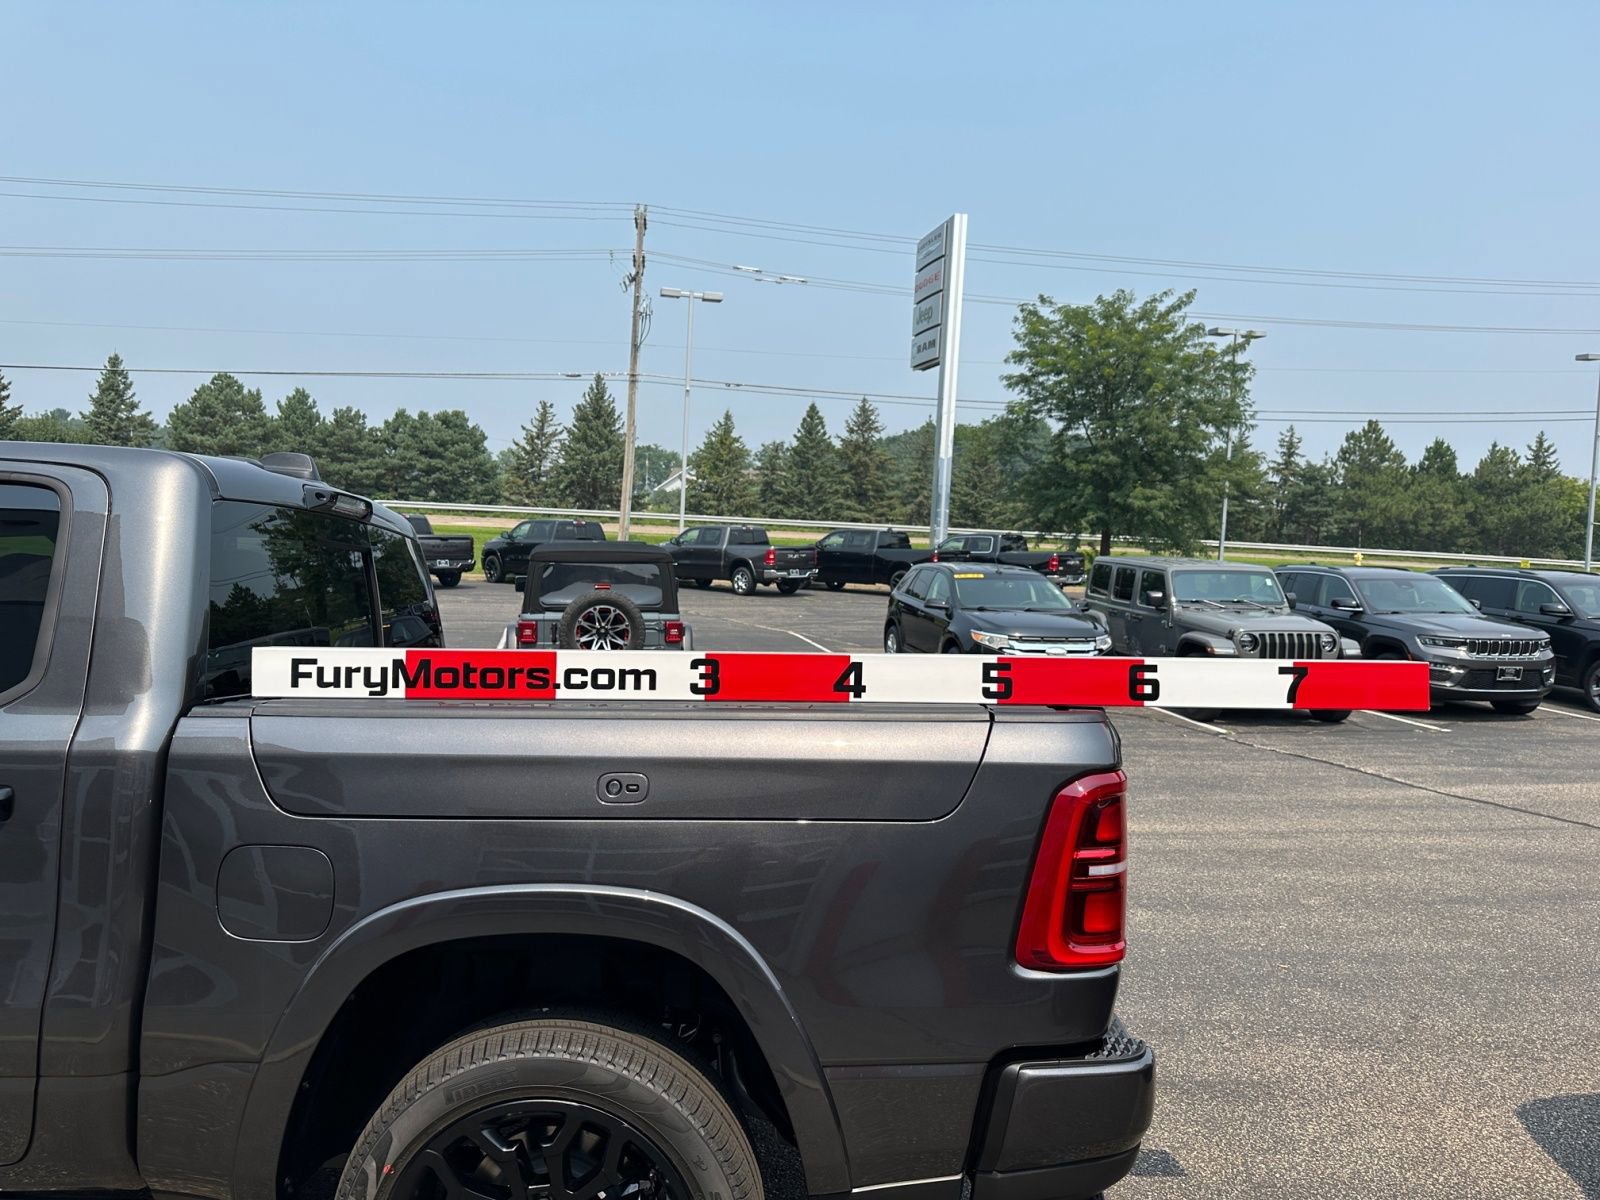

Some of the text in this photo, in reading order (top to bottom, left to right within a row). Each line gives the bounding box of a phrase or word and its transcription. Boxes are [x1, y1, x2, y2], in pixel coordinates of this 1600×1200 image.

[916, 305, 933, 325] Jeep
[917, 339, 936, 354] RAM
[290, 658, 1309, 704] FuryMotors.com 3 4 5 6 7
